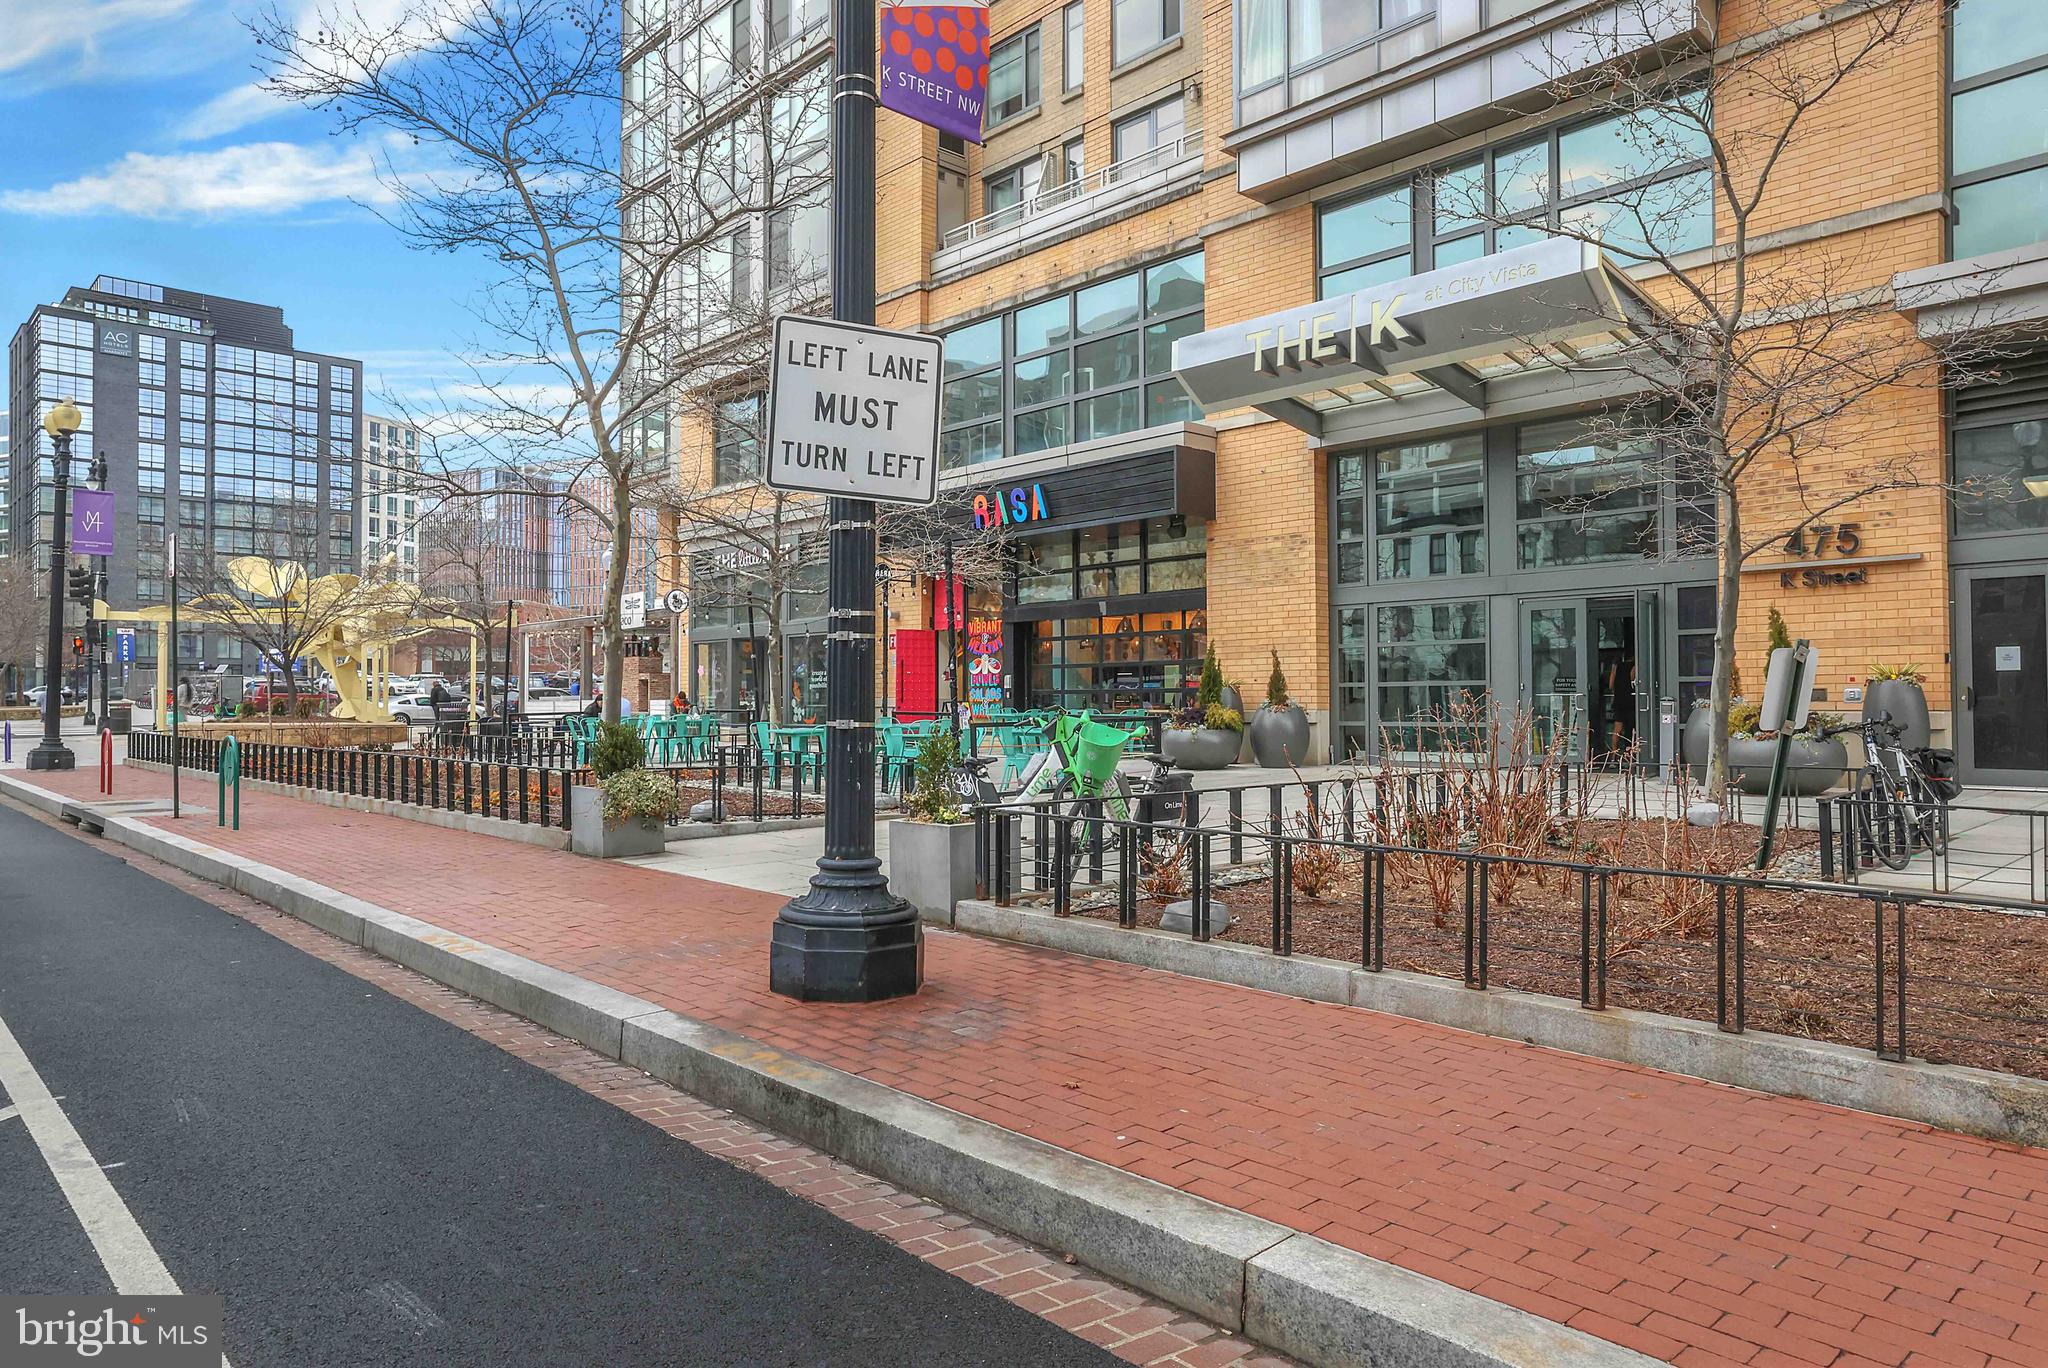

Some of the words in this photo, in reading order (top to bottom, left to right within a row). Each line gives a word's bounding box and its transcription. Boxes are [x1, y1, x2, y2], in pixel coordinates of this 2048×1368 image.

[882, 65, 892, 83] K
[898, 71, 953, 104] STREET
[958, 94, 981, 117] NW
[1424, 285, 1443, 303] at
[1448, 276, 1486, 296] City
[1488, 263, 1537, 285] Vista
[104, 331, 128, 344] AC
[1246, 311, 1337, 372] THE
[1370, 293, 1410, 346] K
[787, 339, 848, 372] LEFT
[867, 352, 929, 384] LANE
[814, 391, 899, 431] MUST
[781, 440, 847, 472] TURN
[867, 450, 926, 481] LEFT
[973, 482, 1048, 530] RASA
[1783, 523, 1861, 557] 475
[714, 551, 737, 571] THE
[1780, 570, 1798, 589] K
[1801, 566, 1869, 589] Street
[967, 619, 1003, 635] VIBRANT
[122, 634, 130, 656] PARK
[967, 635, 1004, 655] HEALTHY
[970, 673, 1001, 687] BOWLS
[970, 687, 1003, 700] SALADS
[1026, 767, 1052, 798] Lime
[1164, 802, 1173, 810] On
